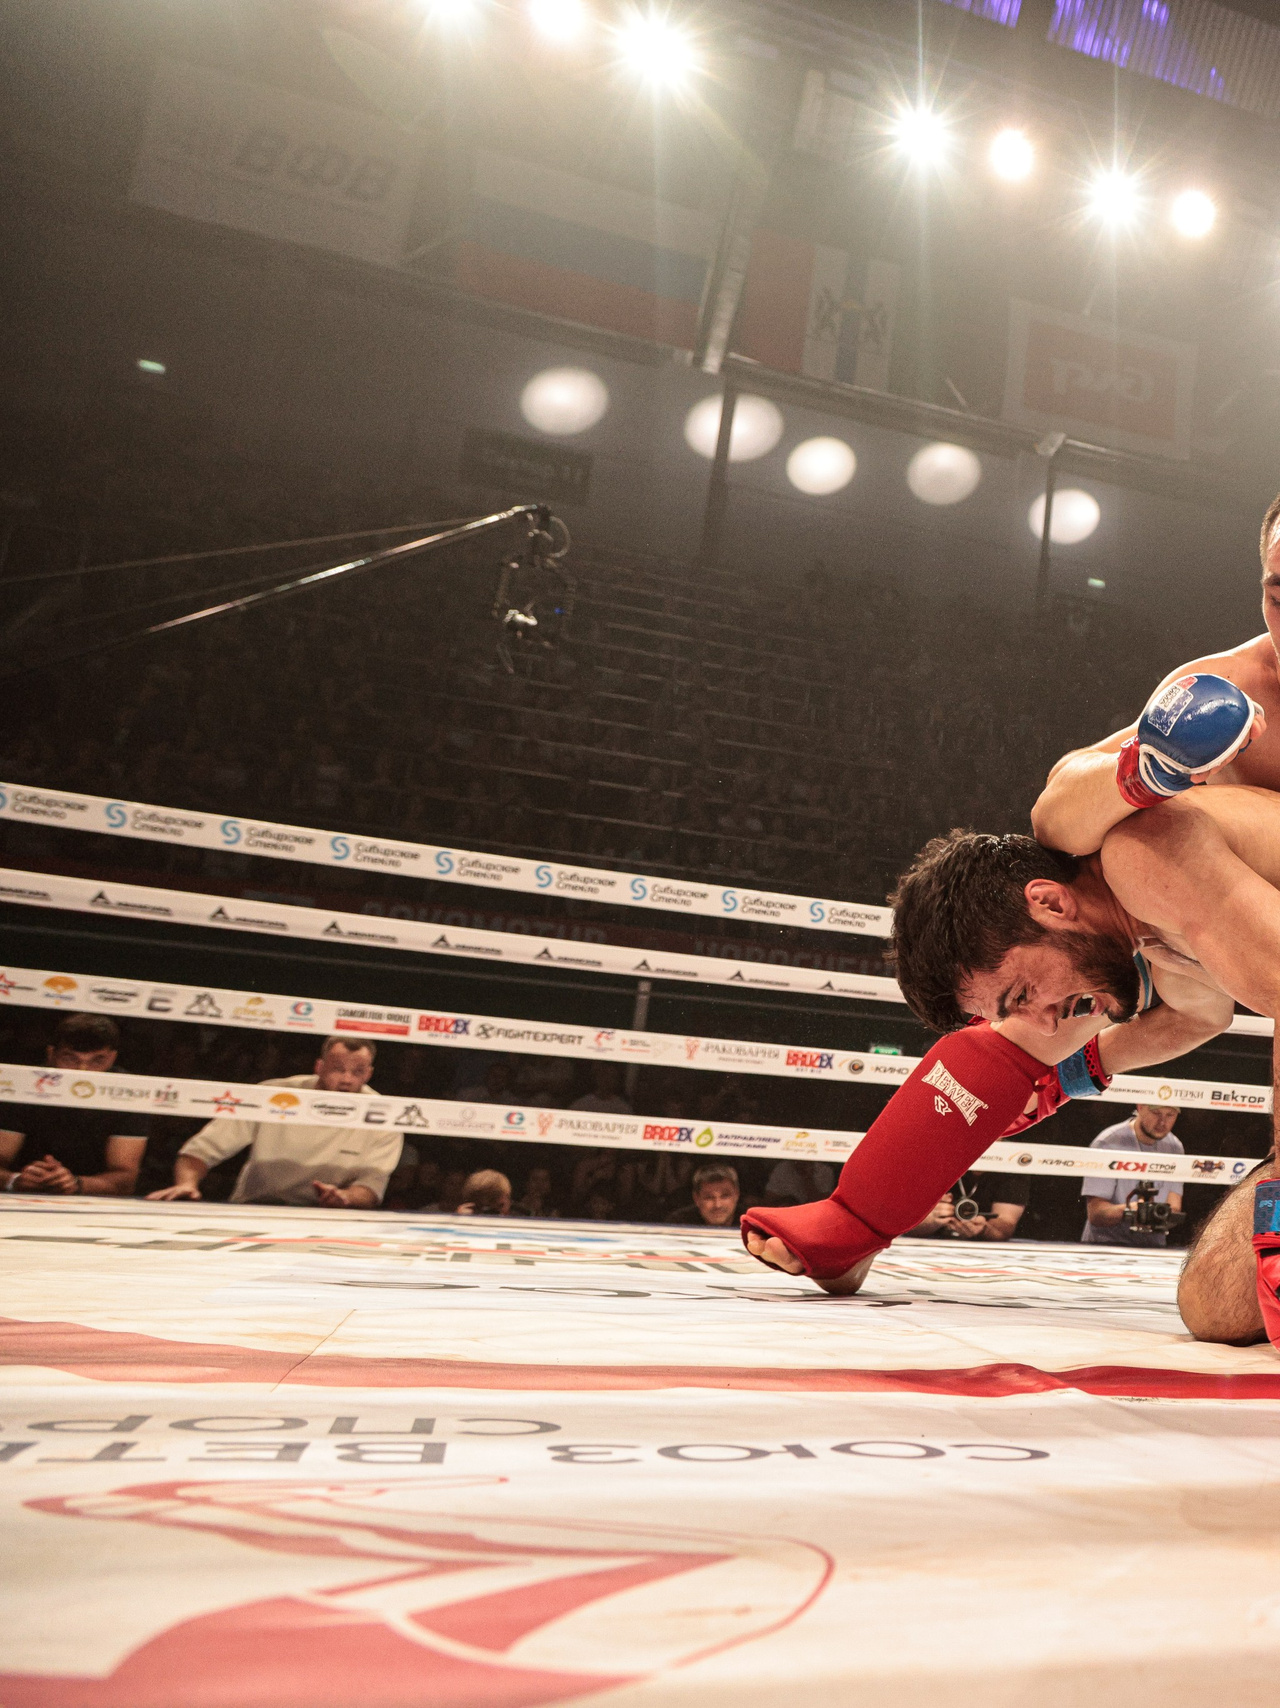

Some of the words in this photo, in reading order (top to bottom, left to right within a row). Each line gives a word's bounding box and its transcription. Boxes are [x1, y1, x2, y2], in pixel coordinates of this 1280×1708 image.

[741, 905, 780, 918] Стекло
[742, 896, 797, 912] Сибирское
[828, 916, 865, 928] Стекло
[829, 907, 882, 922] Сибирское
[497, 1027, 584, 1046] FIGHTEXPERT
[786, 1050, 834, 1070] BROZEX
[921, 1059, 984, 1126] REYVEL
[643, 1124, 695, 1142] BROZEX
[0, 1414, 562, 1437] СПОР
[547, 1440, 1050, 1463] СОЮЗ
